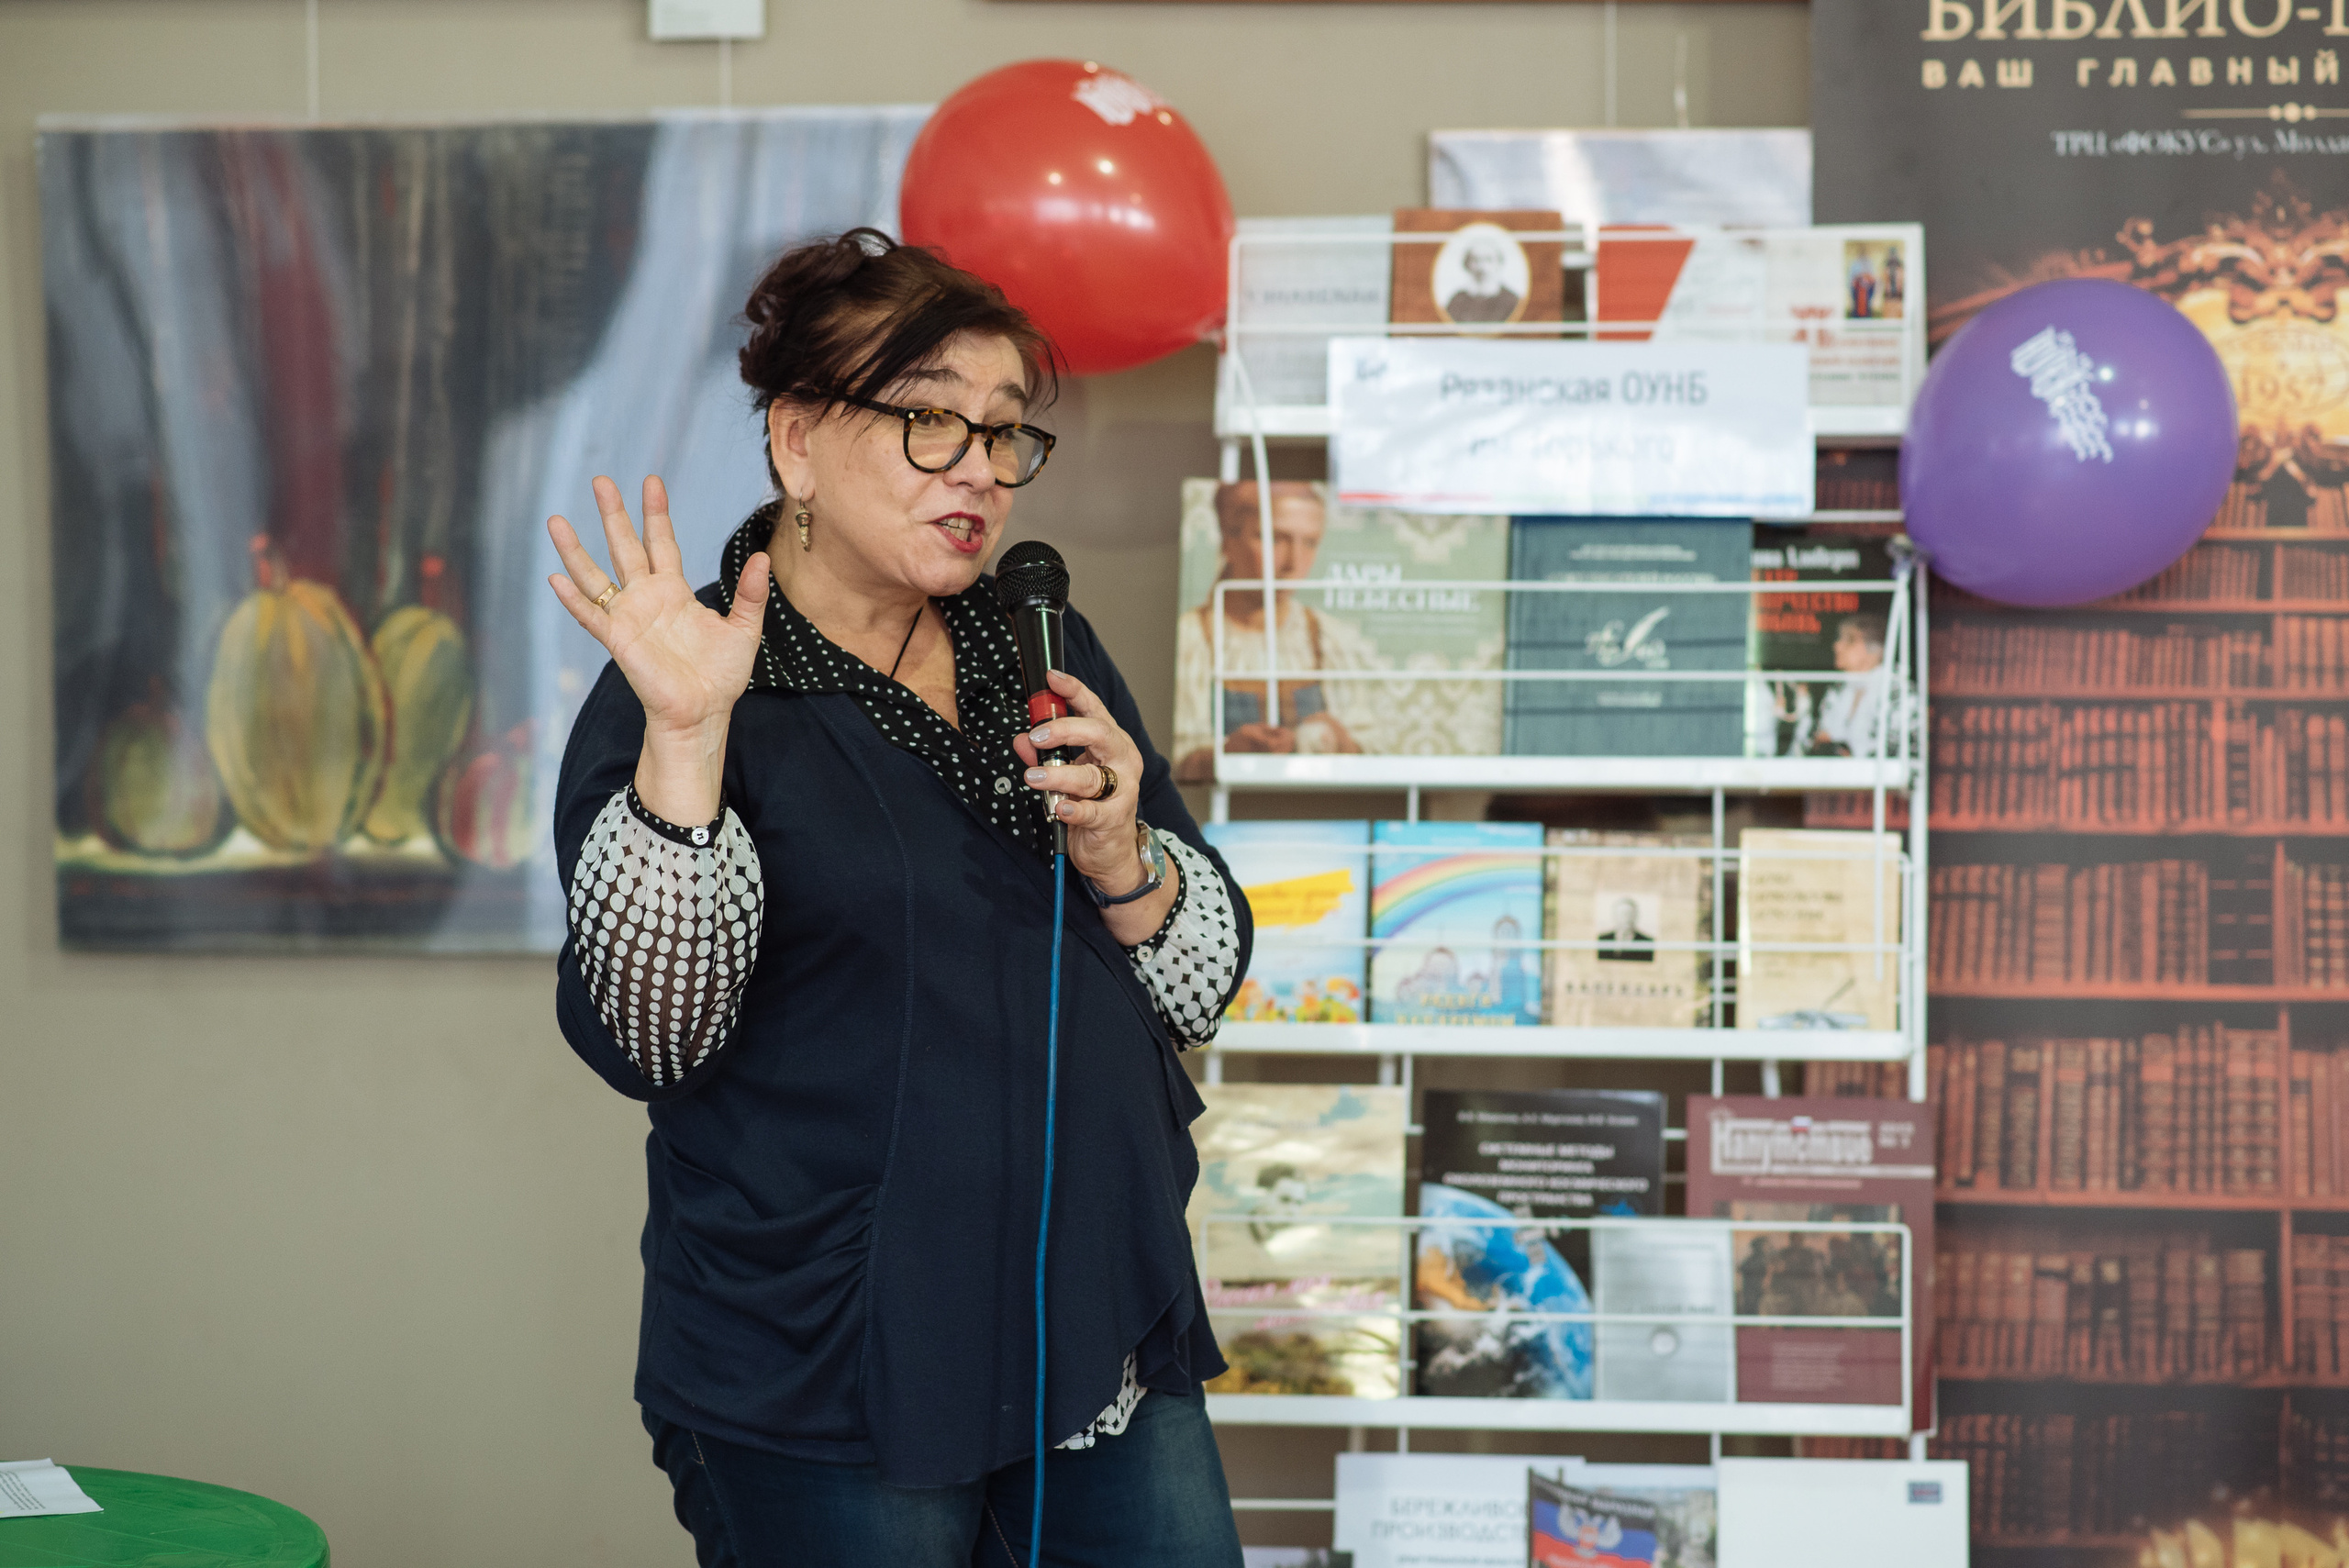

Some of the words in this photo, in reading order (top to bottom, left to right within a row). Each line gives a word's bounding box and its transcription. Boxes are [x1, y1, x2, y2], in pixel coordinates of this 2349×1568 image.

[1921, 59, 2033, 89] ВАШ
[2076, 49, 2340, 88] ГЛАВНЫЙ
[1620, 370, 1709, 406] ОУНБ
[1389, 1496, 1527, 1518] БЕРЕЖЛИВО
